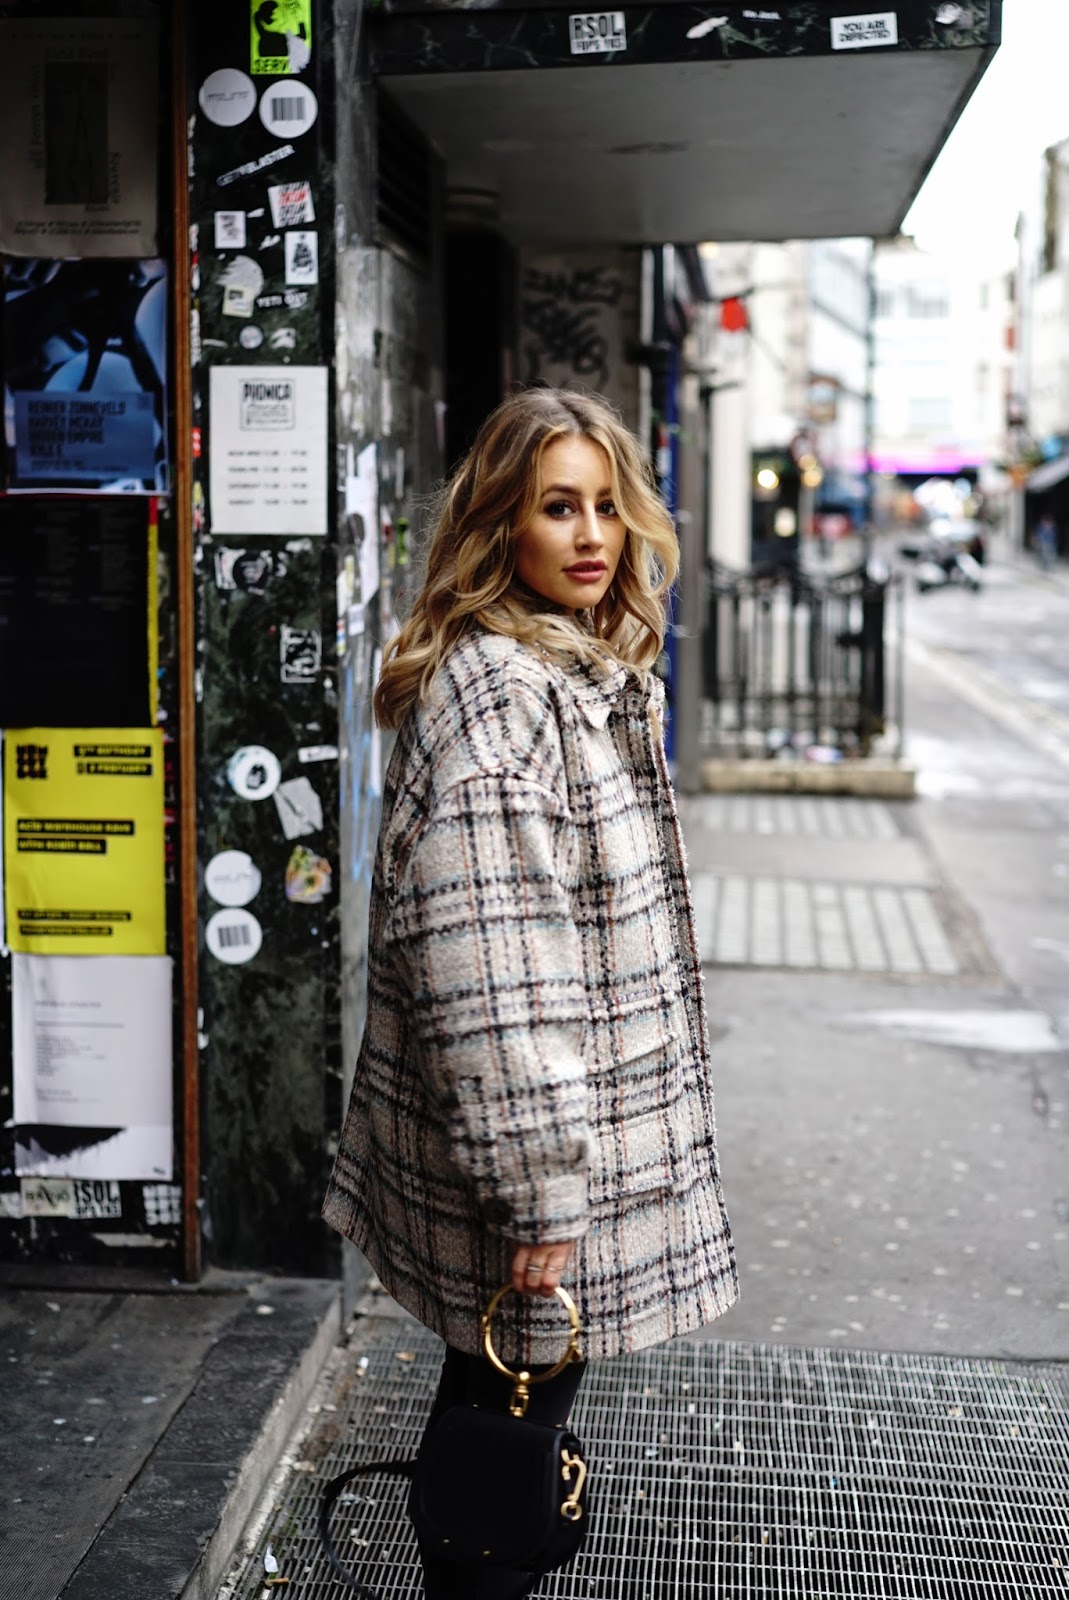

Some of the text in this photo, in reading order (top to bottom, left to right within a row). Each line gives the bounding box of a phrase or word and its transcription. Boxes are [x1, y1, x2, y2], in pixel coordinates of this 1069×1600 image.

[843, 20, 886, 31] YOU ARE
[839, 30, 891, 42] DEFECTED
[243, 383, 291, 400] PHONICA
